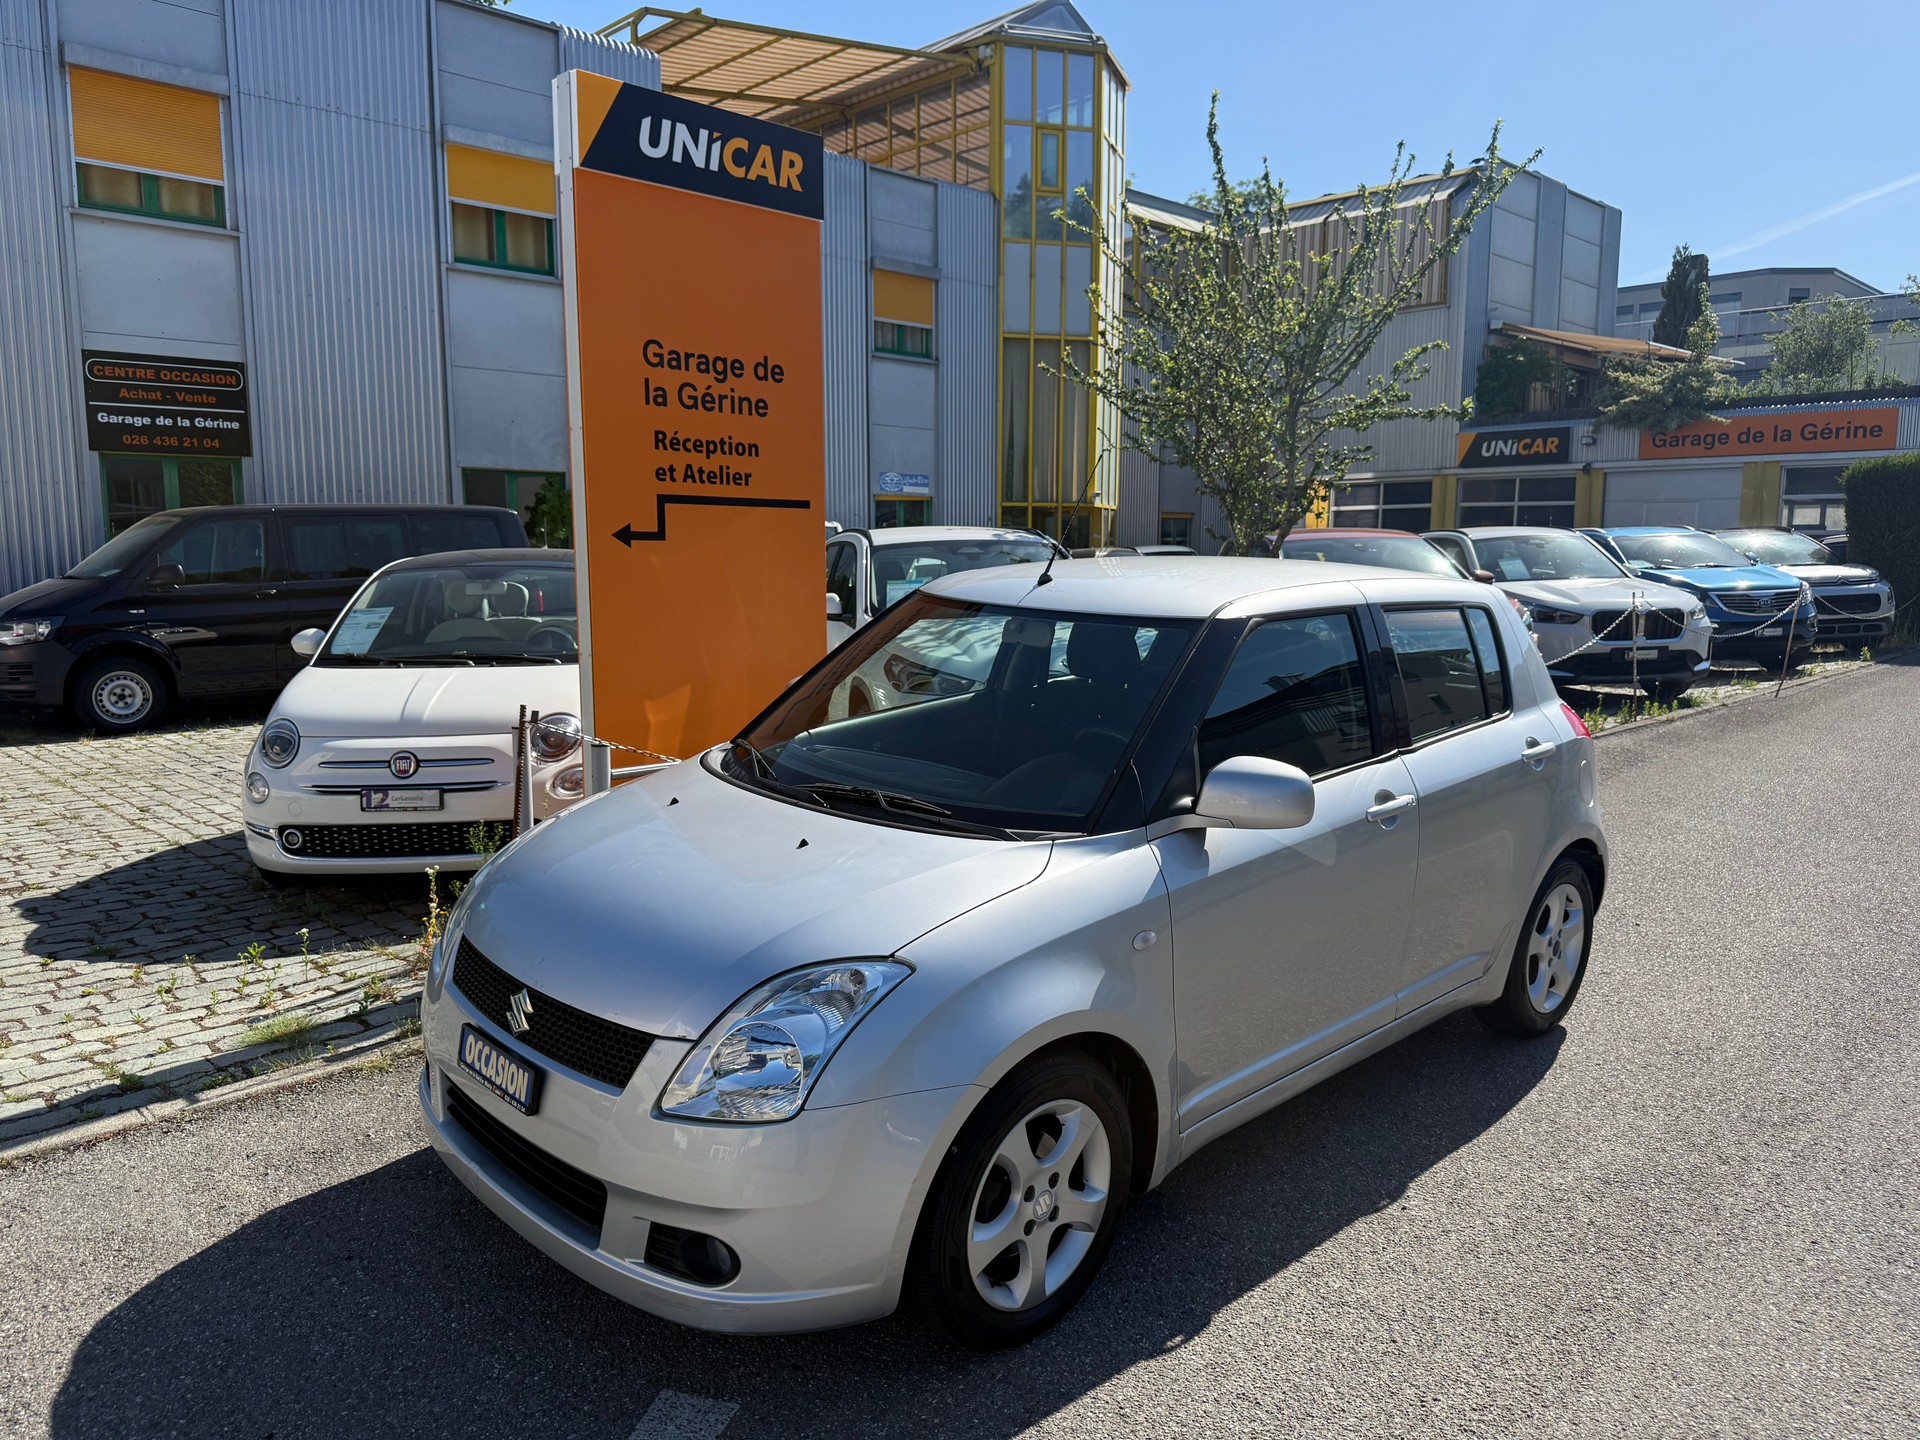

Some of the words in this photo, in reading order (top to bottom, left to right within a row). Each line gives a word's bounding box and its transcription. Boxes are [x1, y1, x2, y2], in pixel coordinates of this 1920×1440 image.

[642, 339, 745, 384] Garage
[753, 355, 784, 383] de
[93, 365, 155, 379] CENTRE
[160, 370, 236, 385] OCCASION
[119, 388, 162, 400] Achat
[175, 391, 217, 404] Vente
[644, 377, 668, 407] la
[677, 382, 769, 418] Gérine
[97, 412, 151, 427] Garage
[155, 415, 173, 426] de
[177, 416, 190, 427] la
[194, 417, 240, 429] Gérine
[122, 434, 149, 445] 026
[153, 435, 179, 446] 436
[183, 437, 198, 447] 21
[203, 438, 220, 449] 04
[654, 430, 759, 459] Réception
[1652, 431, 1730, 450] Garage
[1737, 427, 1765, 444] de
[1773, 425, 1792, 443] la
[1800, 421, 1883, 441] Gérine
[655, 464, 676, 483] et
[682, 463, 752, 486] Atelier
[396, 759, 410, 771] FIAT
[465, 1034, 529, 1103] OCCASION
